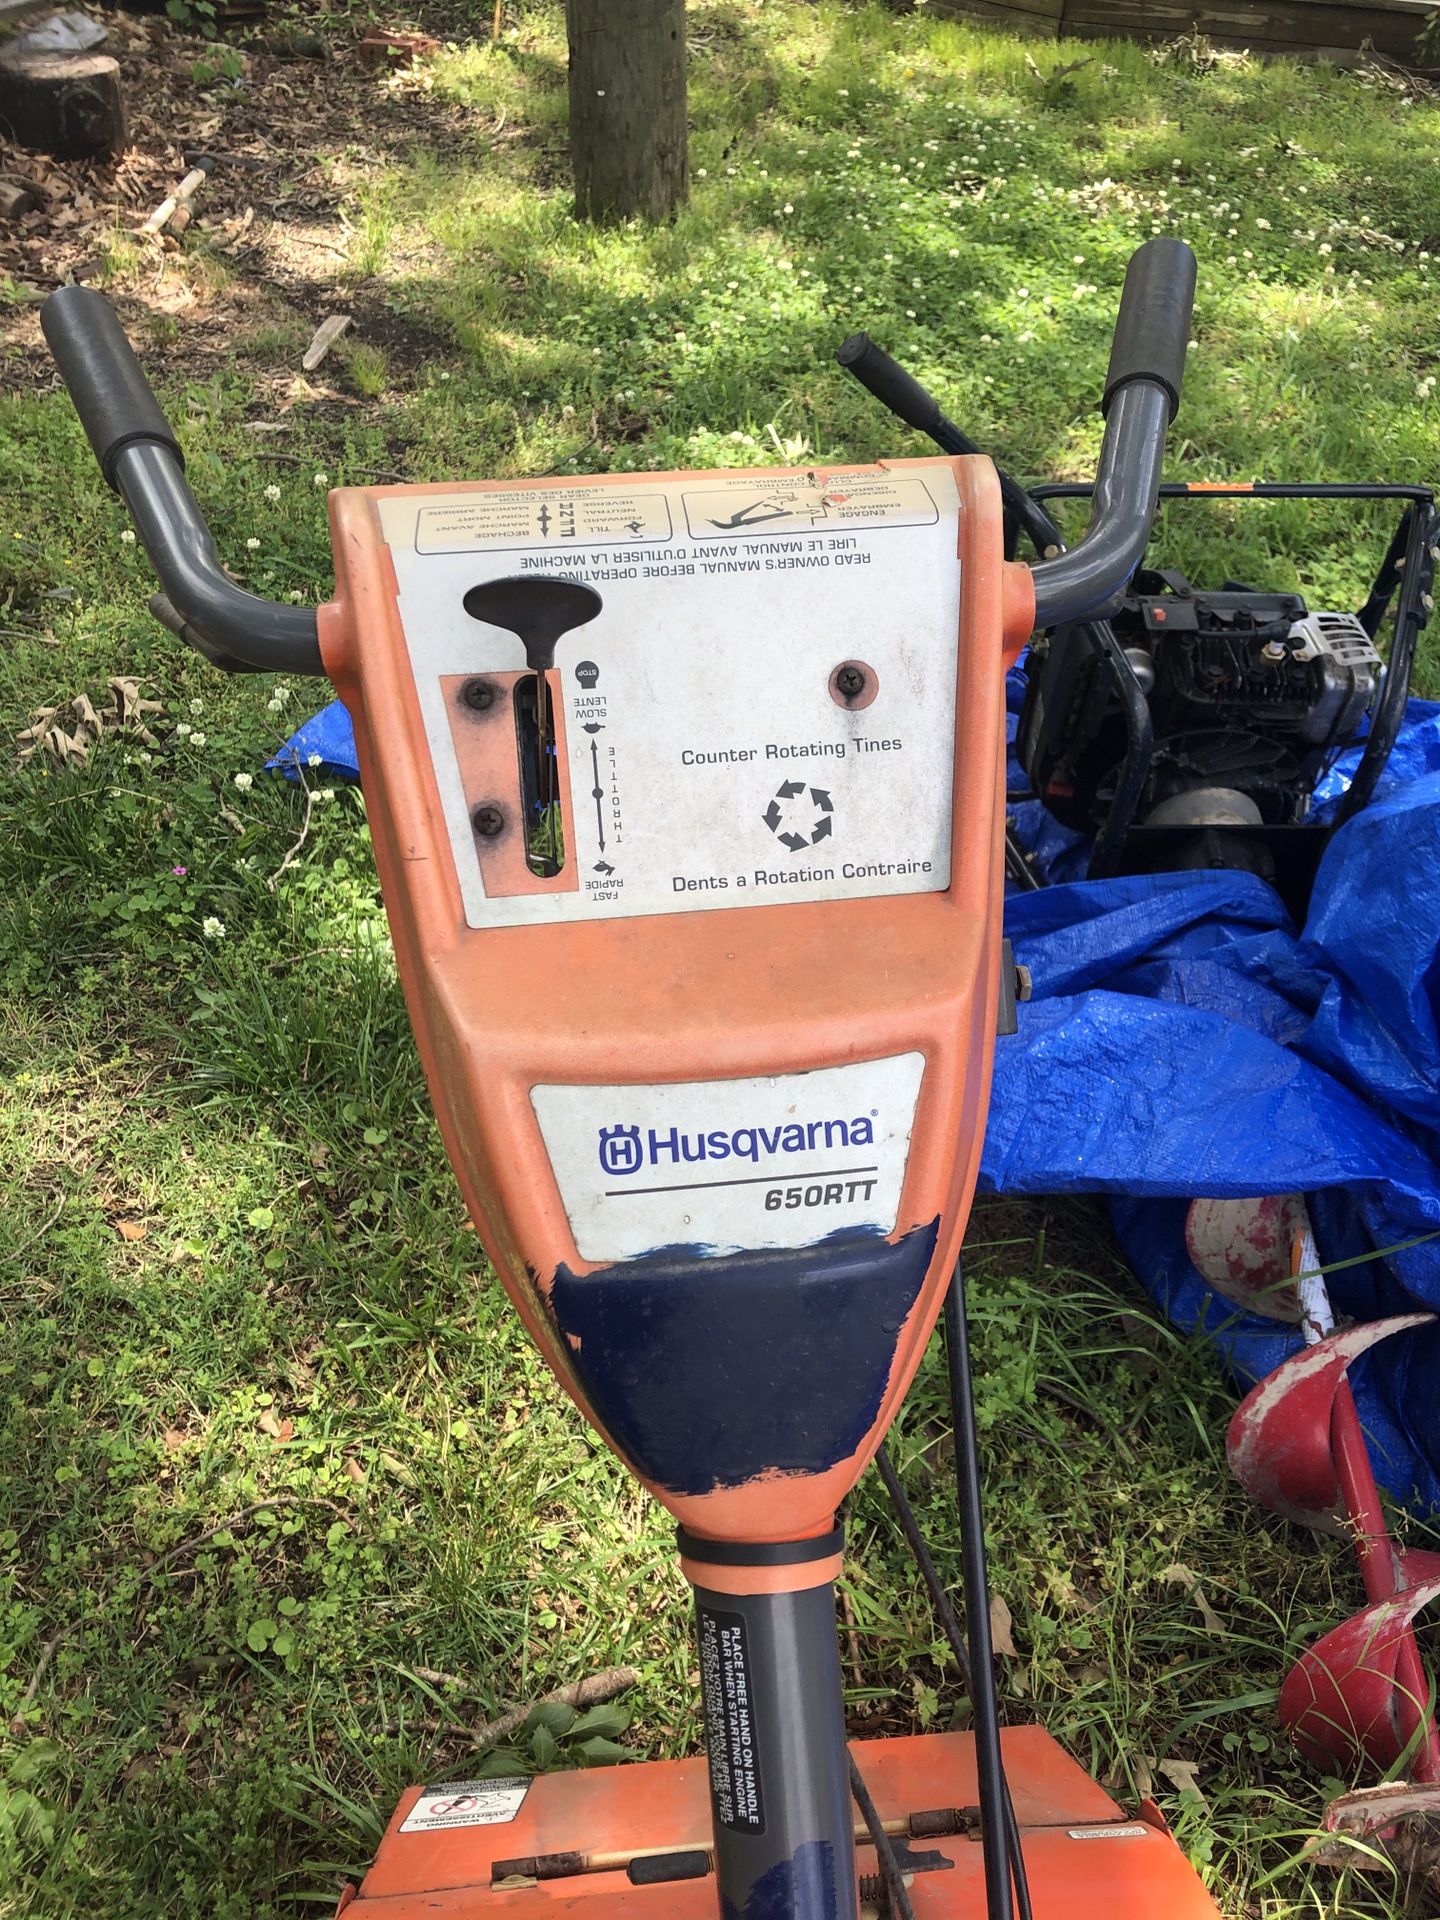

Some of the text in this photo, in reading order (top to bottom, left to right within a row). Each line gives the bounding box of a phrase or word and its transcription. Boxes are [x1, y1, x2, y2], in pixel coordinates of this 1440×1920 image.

[498, 494, 557, 502] SELECTOR
[480, 505, 529, 513] MARCHE
[583, 507, 636, 515] NEUTRAL
[837, 503, 901, 511] EMBRAYER
[839, 510, 886, 518] ENGAGE
[474, 530, 530, 539] BECHAGE
[520, 538, 857, 568] LIRE LE MANUAL AVANT D'UTILISER LA MACHINE
[834, 553, 871, 565] READ
[700, 559, 760, 573] MANUAL
[766, 555, 830, 569] OWNER'S
[642, 562, 694, 577] BEFORE
[574, 697, 607, 707] LENTE
[576, 709, 607, 718] SLOW
[681, 737, 903, 766] Counter Rotating Tines
[672, 858, 932, 893] Dents a Rotation Contraire
[585, 879, 624, 889] RAPIDE
[592, 891, 618, 901] FAST
[764, 1179, 878, 1211] 650RTT
[703, 1614, 709, 1629] LE
[709, 1620, 734, 1822] PLACEZ VOTRE MAIN LIBRE SUR
[721, 1630, 747, 1817] BAR WHEN STARTING ENGINE
[731, 1627, 759, 1824] PLACE FREE HAND ON HANDLE
